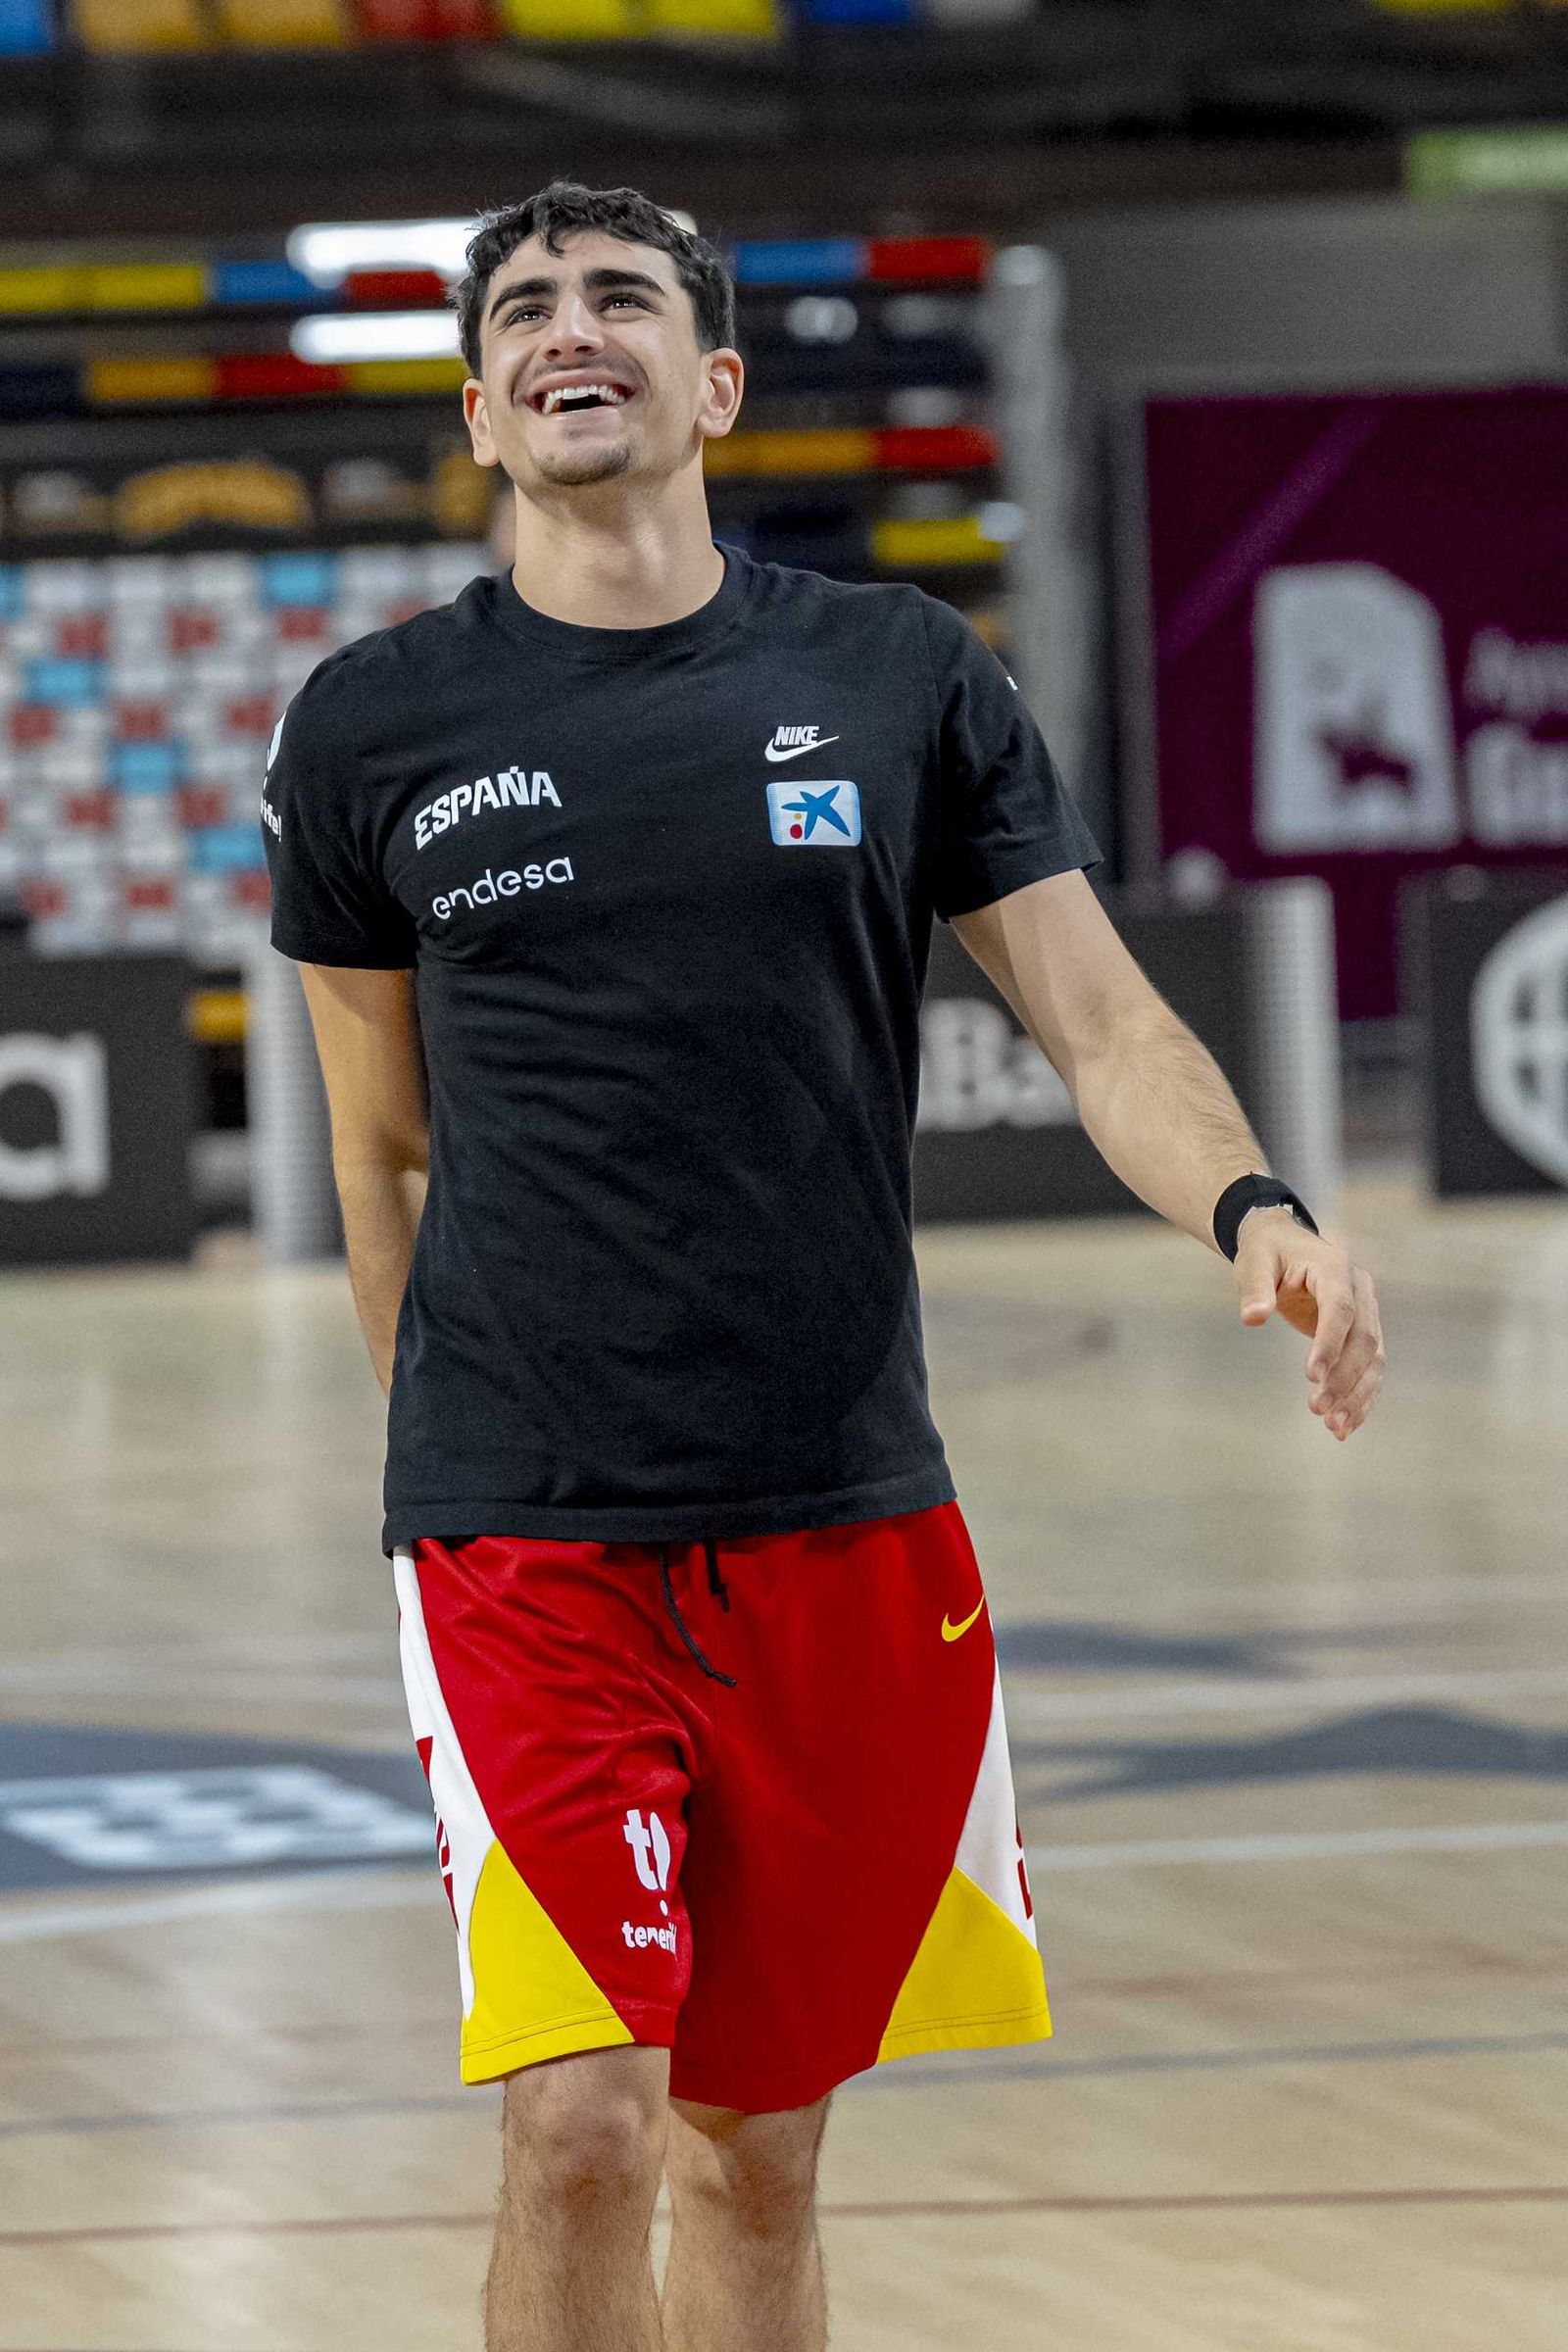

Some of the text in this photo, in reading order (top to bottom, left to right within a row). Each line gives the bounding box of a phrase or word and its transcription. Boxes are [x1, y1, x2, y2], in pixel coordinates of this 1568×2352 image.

[774, 725, 819, 746] NIKE
[415, 766, 563, 851] ESPAÑA
[432, 856, 575, 919] endesa
